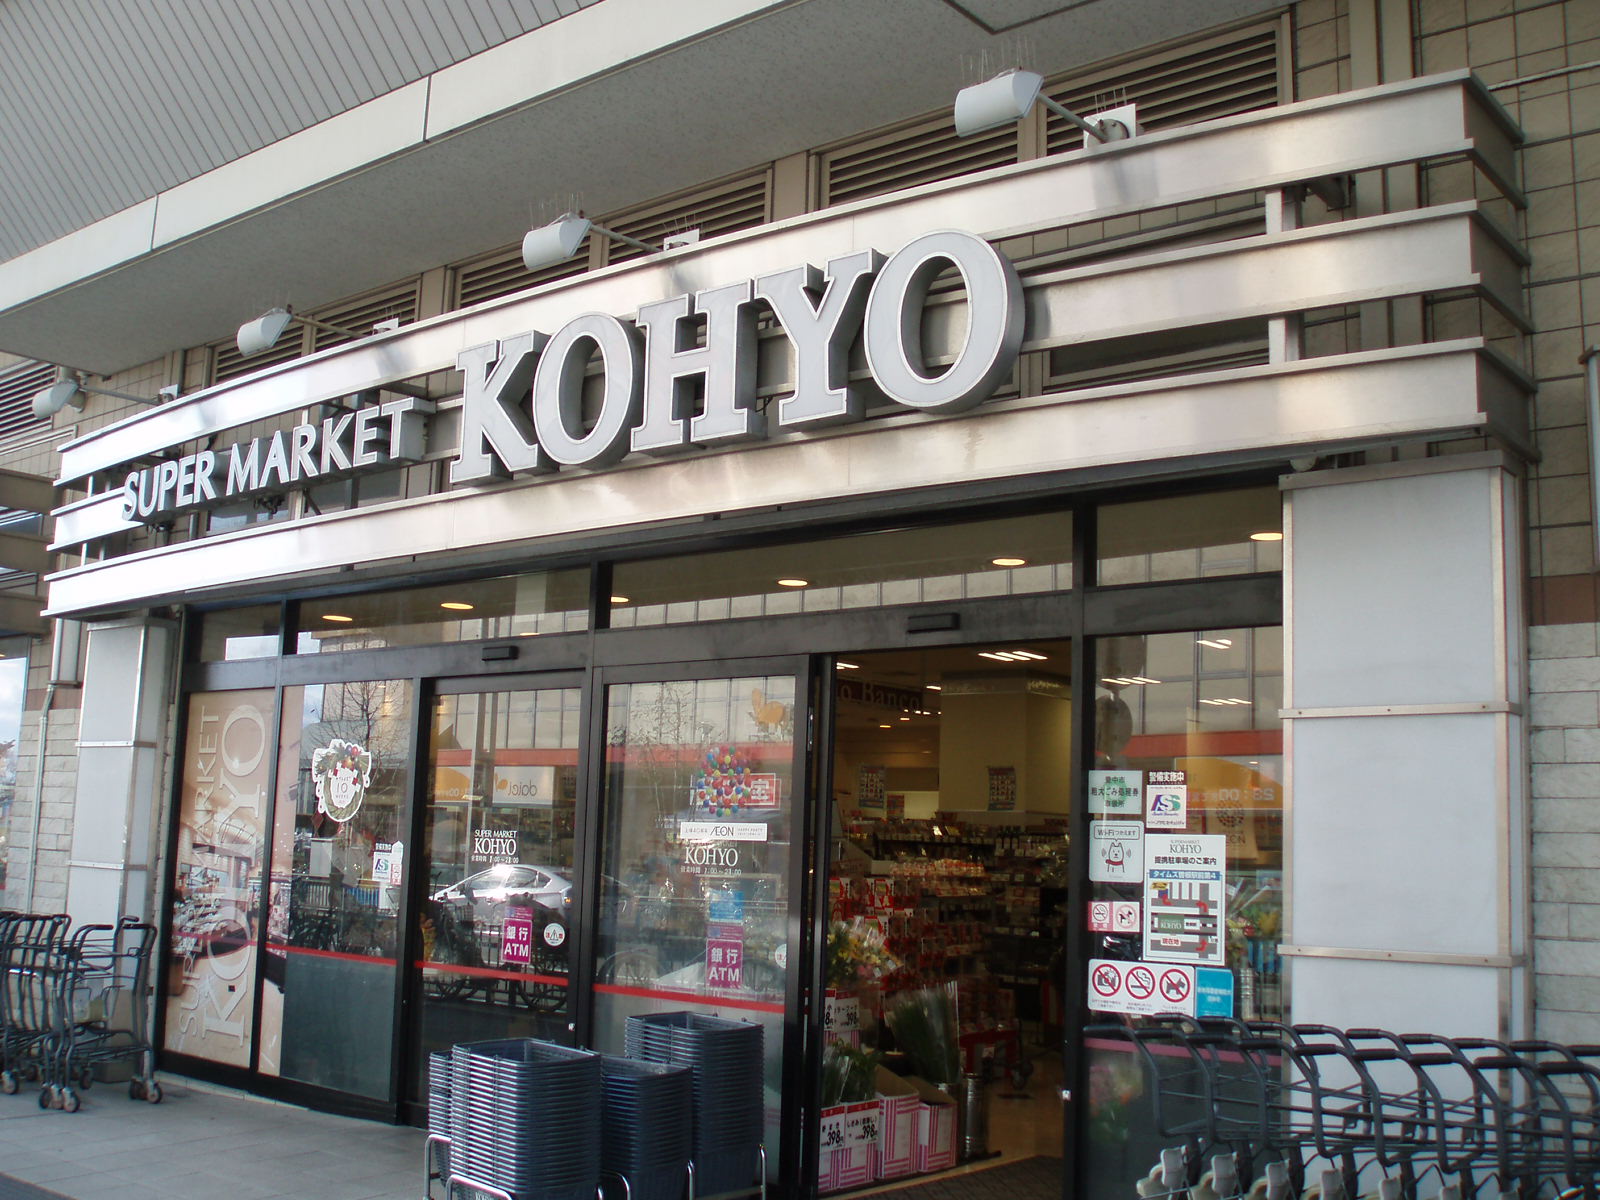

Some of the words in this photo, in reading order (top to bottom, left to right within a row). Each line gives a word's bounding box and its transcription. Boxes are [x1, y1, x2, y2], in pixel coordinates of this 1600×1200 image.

[450, 228, 1014, 485] KOHYO
[122, 450, 217, 521] SUPER
[226, 396, 416, 496] MARKET
[191, 705, 219, 886] MARKET
[474, 829, 492, 838] SUPER
[493, 830, 518, 839] MARKET
[473, 838, 517, 856] KOHYO
[1169, 844, 1202, 854] KOHYO
[684, 846, 739, 867] KOHYO
[202, 704, 266, 1048] KOHYO
[506, 926, 529, 941] 銀行
[504, 942, 529, 957] ATM
[711, 947, 738, 964] 銀行
[709, 966, 740, 982] ATM
